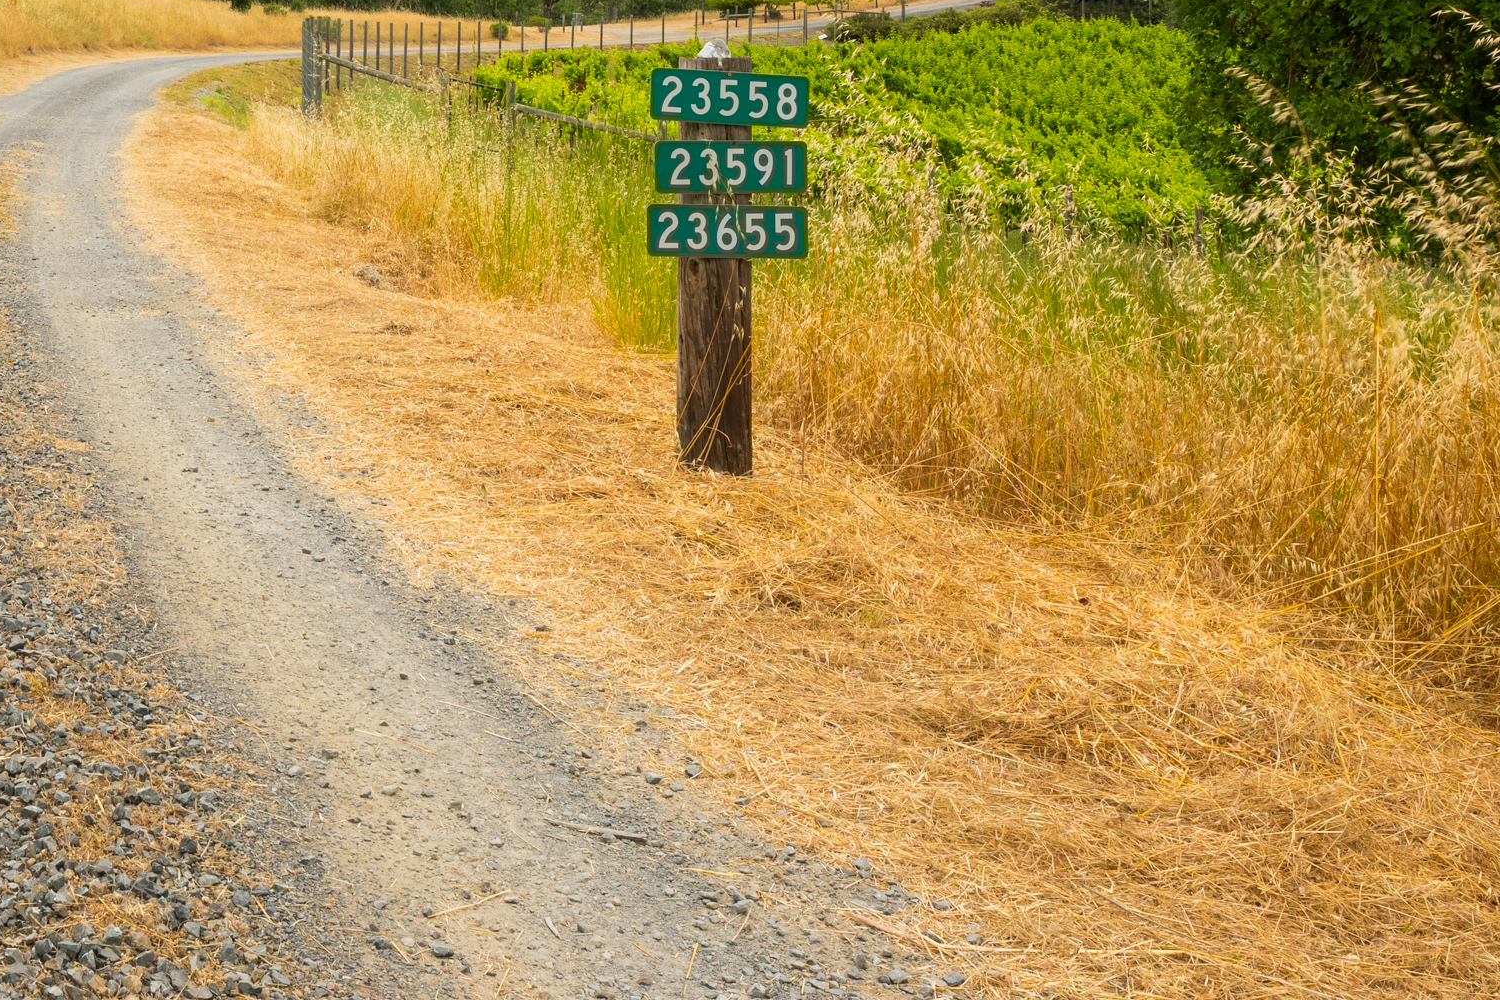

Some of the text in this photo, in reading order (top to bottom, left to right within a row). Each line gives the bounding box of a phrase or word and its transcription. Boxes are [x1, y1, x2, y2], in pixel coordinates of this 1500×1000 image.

[661, 75, 798, 121] 23558
[670, 147, 793, 186] 23591
[657, 211, 796, 251] 23655
